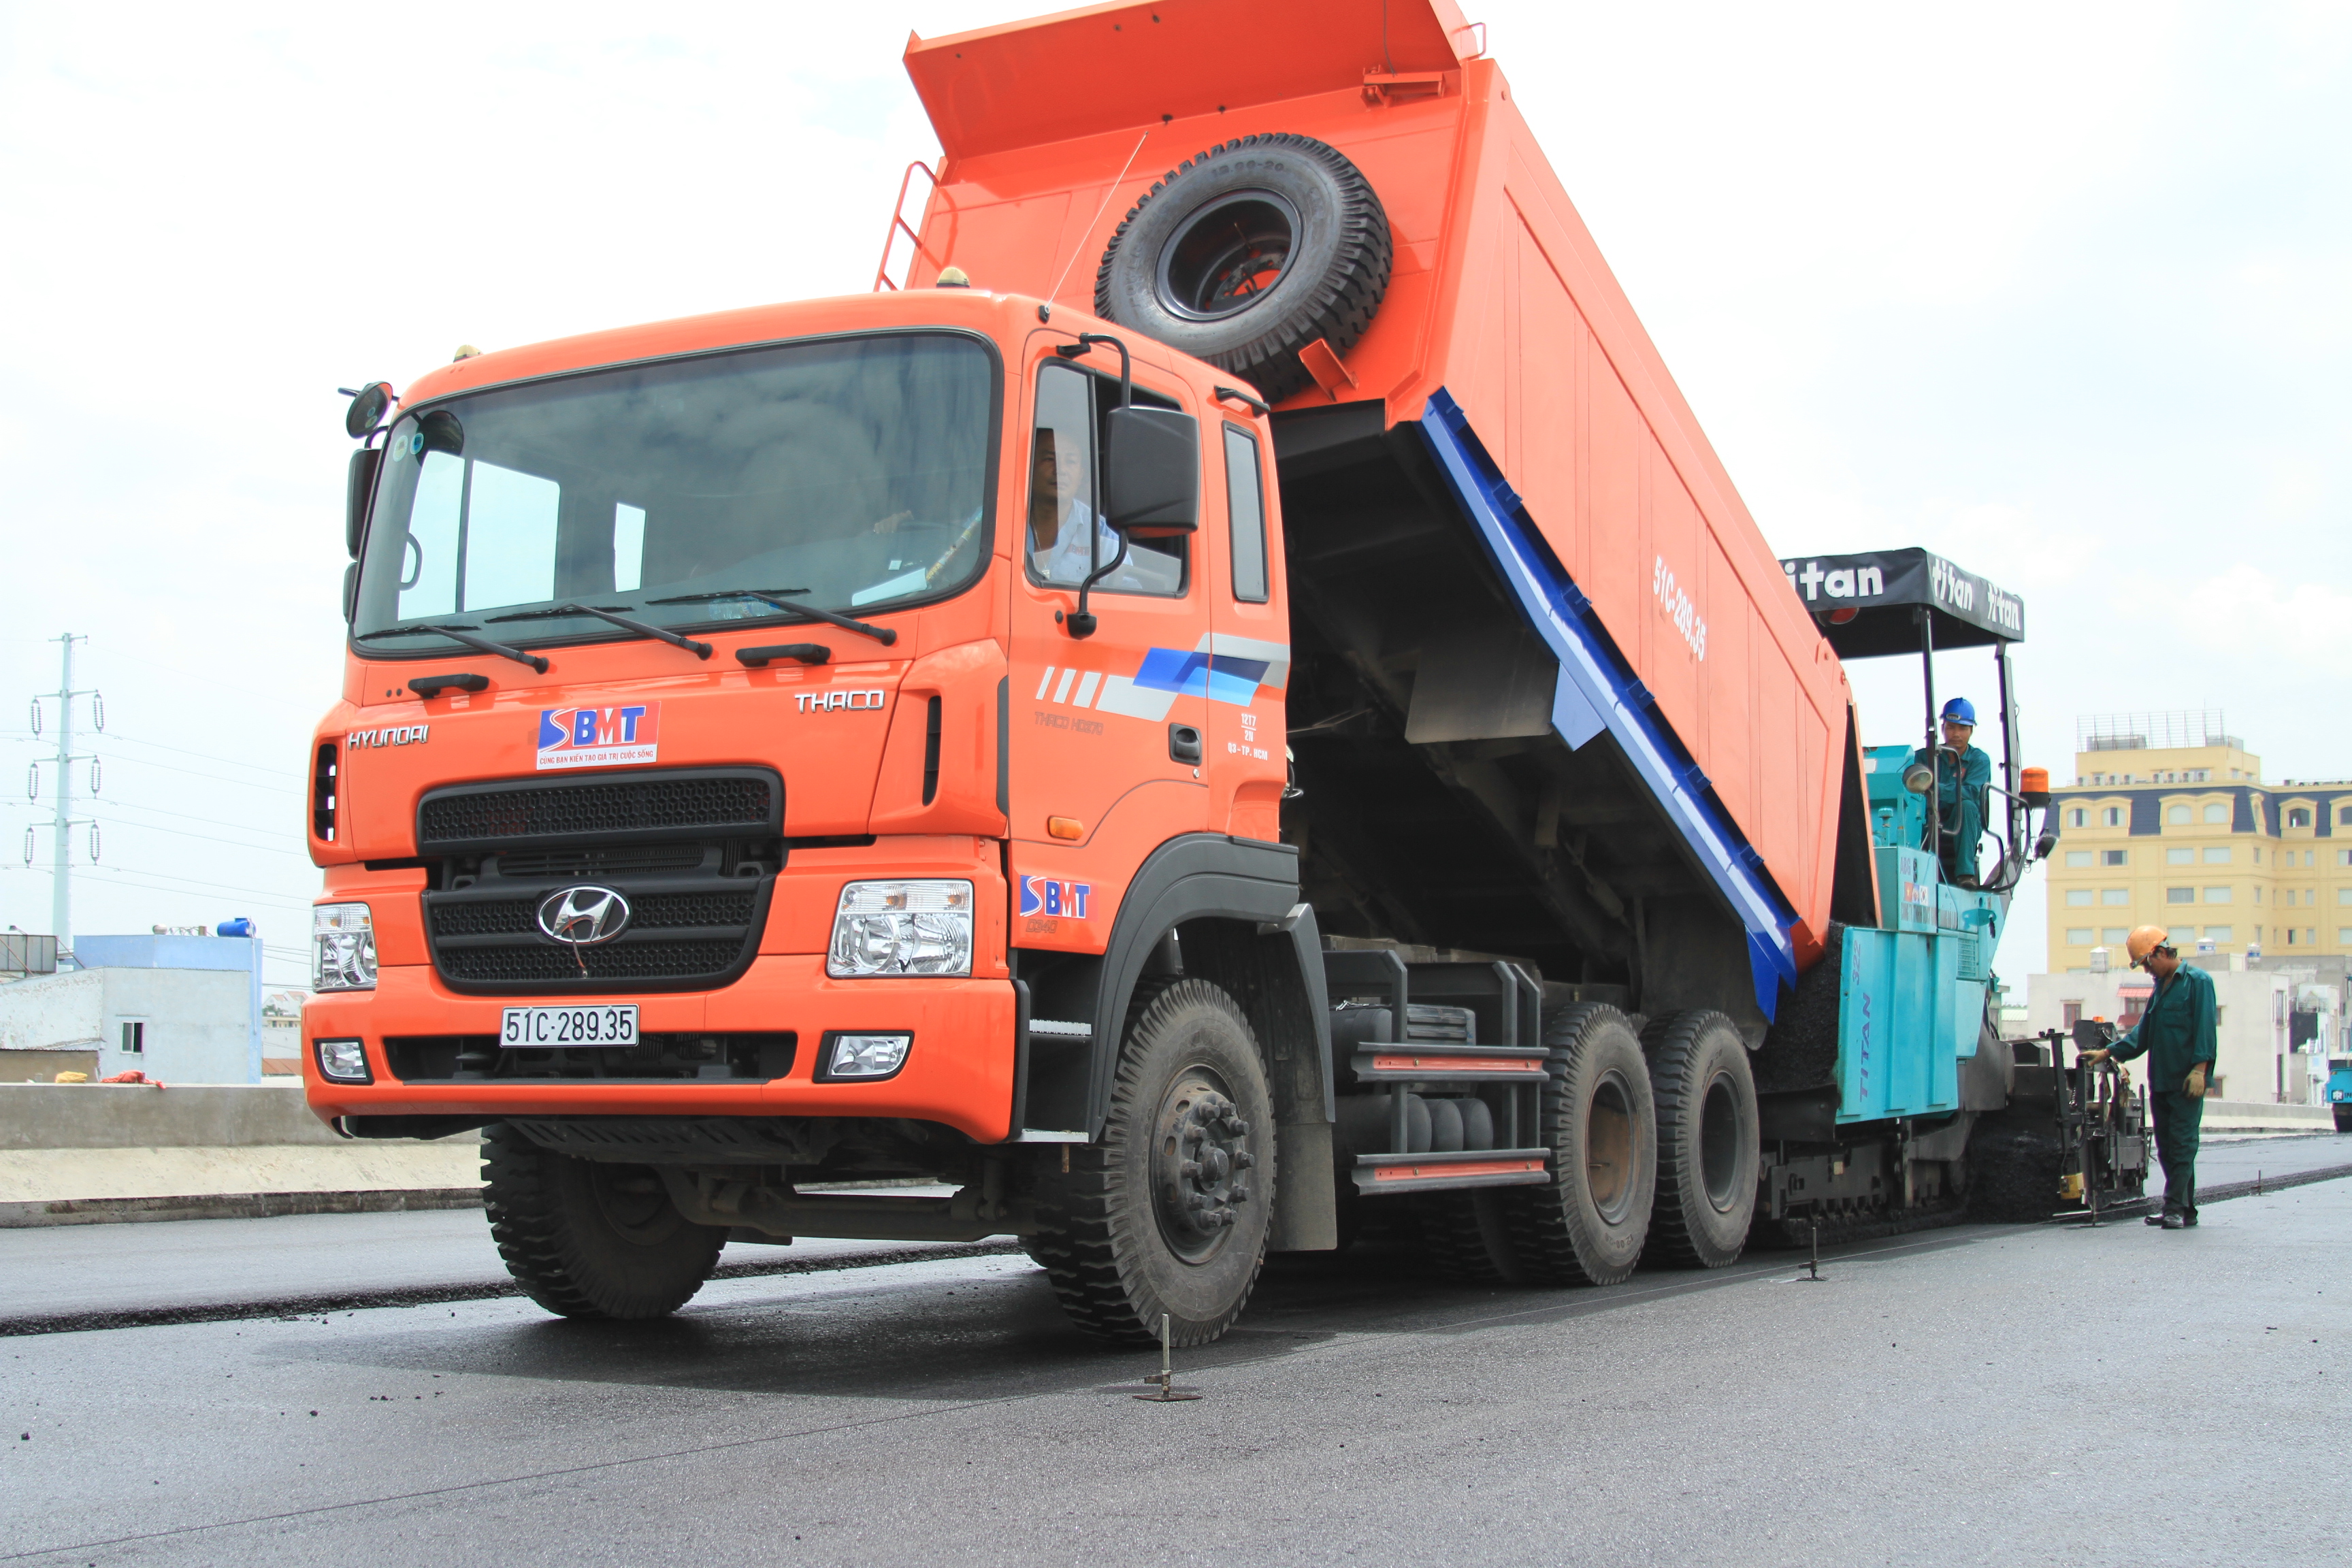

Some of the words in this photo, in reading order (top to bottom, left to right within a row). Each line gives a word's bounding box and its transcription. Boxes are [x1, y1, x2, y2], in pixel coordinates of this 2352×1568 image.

[1932, 558, 1973, 612] titan
[1987, 583, 2021, 632] titan
[794, 689, 884, 714] THACO
[537, 705, 647, 753] SBMT
[1034, 711, 1070, 730] THACO
[1241, 713, 1257, 727] 12T7
[1244, 730, 1254, 742] 2N
[348, 725, 429, 751] HYUNDAI
[540, 755, 555, 765] CÙNG
[556, 755, 568, 765] BẠN
[570, 752, 584, 763] KIẾN
[585, 754, 596, 763] TẠO
[598, 753, 607, 761] GIÁ
[609, 753, 619, 762] TRỊ
[620, 751, 635, 760] CUỘC
[638, 749, 653, 758] SỐNG
[1019, 875, 1091, 919] SBMT
[1852, 940, 1861, 986] 322
[1859, 992, 1871, 1102] TITAN
